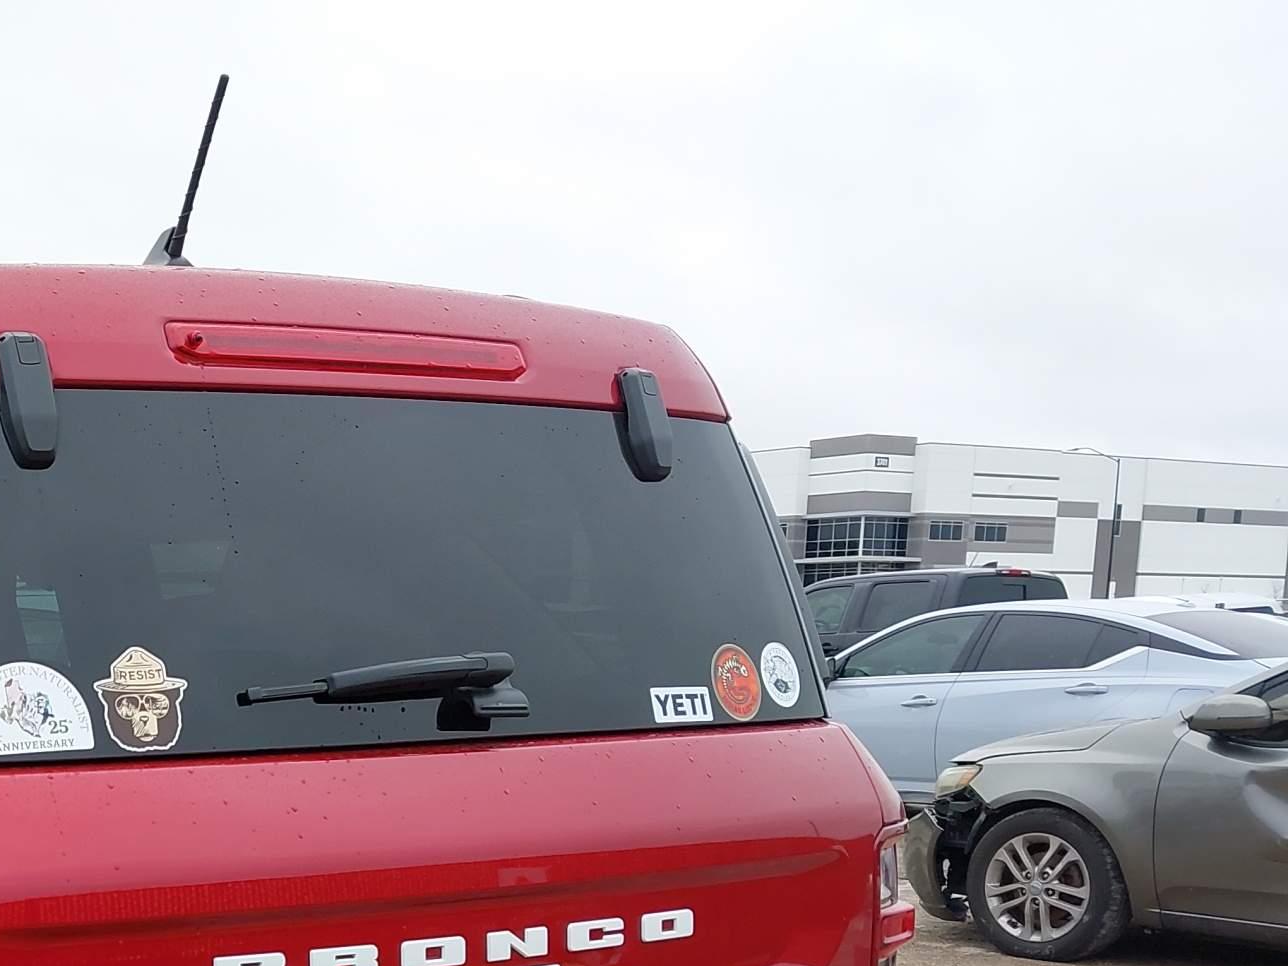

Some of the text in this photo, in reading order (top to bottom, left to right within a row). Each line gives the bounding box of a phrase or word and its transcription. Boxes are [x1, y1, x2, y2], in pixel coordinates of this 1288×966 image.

[119, 669, 162, 681] RESIST
[29, 665, 90, 733] NATURALIST
[654, 693, 708, 717] YETI
